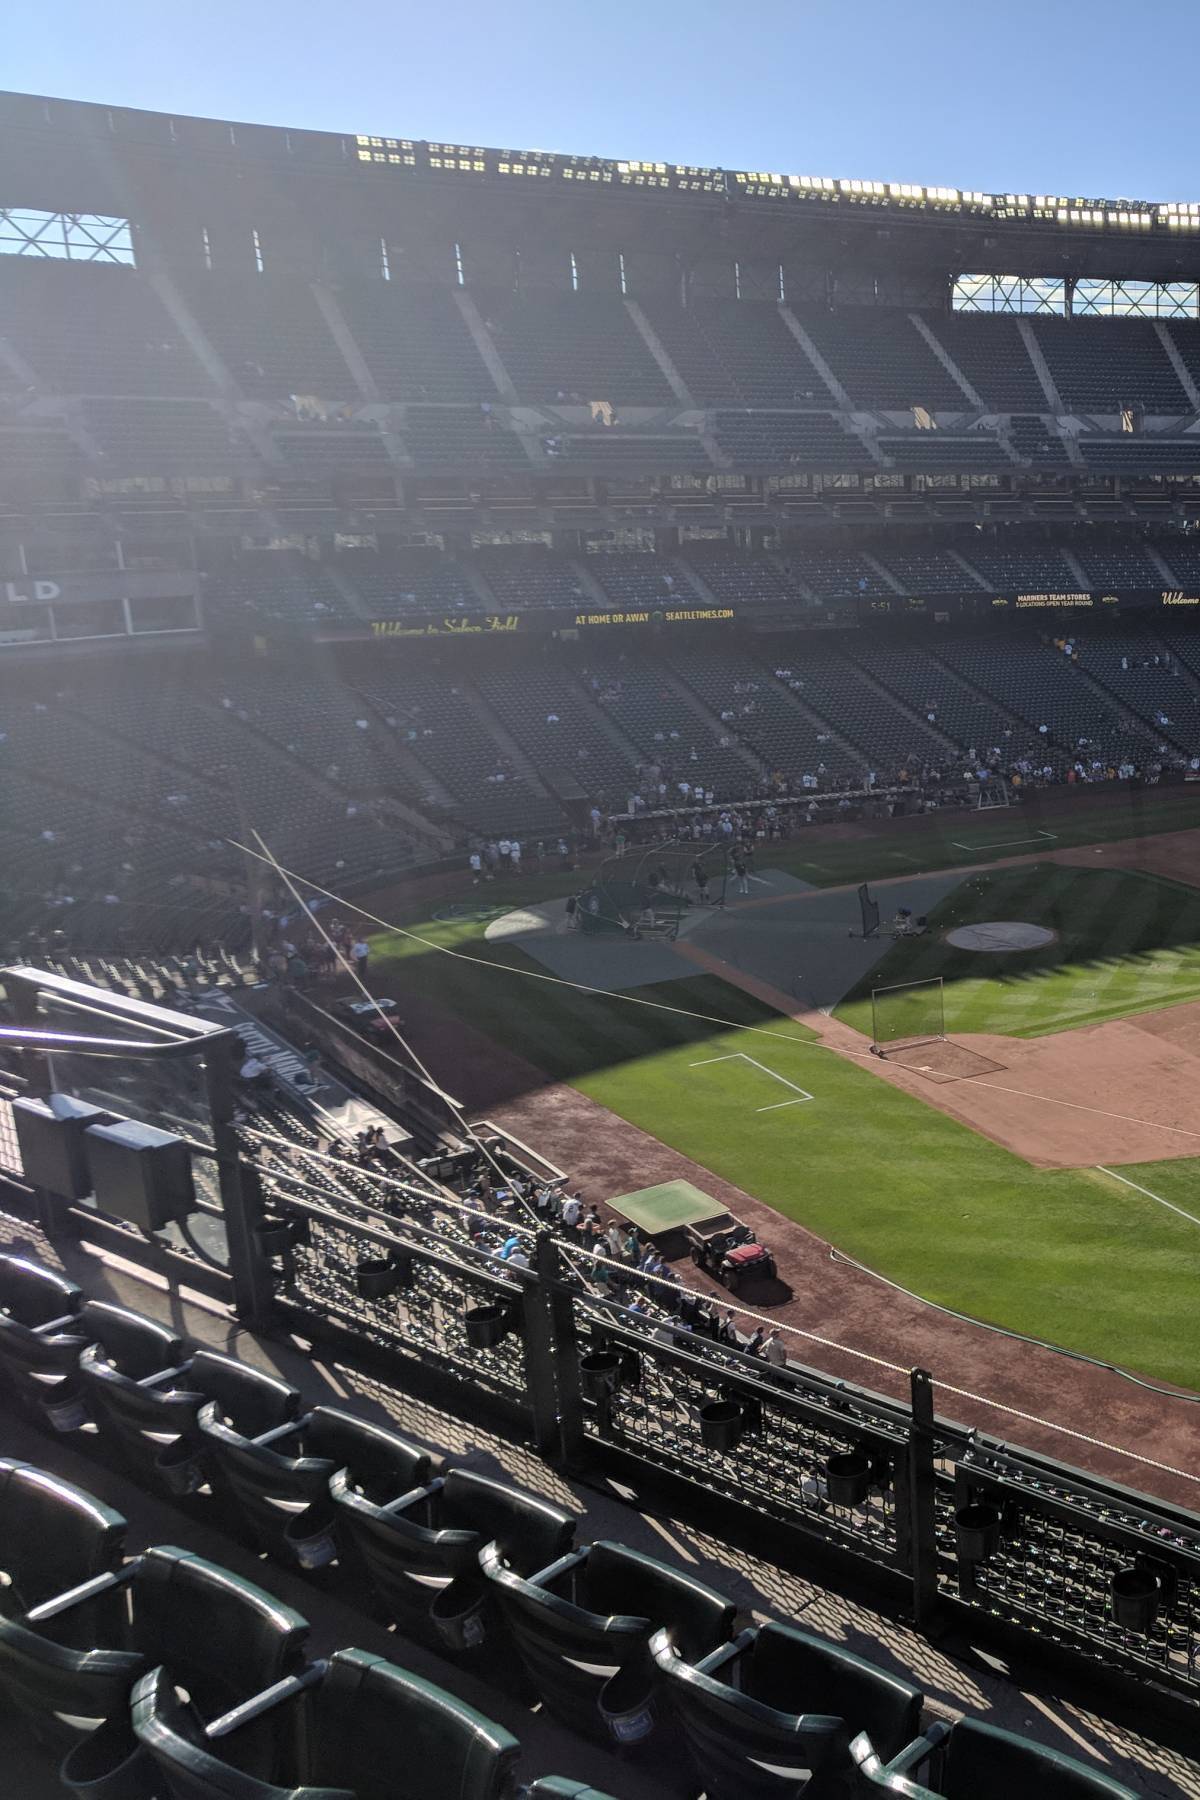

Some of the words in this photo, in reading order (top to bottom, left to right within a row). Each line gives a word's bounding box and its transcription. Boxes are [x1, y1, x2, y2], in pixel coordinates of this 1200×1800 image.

[1049, 593, 1066, 601] TEAM
[1162, 591, 1199, 605] Welcome
[575, 615, 586, 625] AT
[588, 614, 610, 625] HOME
[612, 613, 624, 624] OR
[625, 613, 649, 623] AWAY
[665, 610, 734, 621] SEATTLETIMES.COM
[427, 624, 439, 635] to
[484, 616, 519, 632] Field
